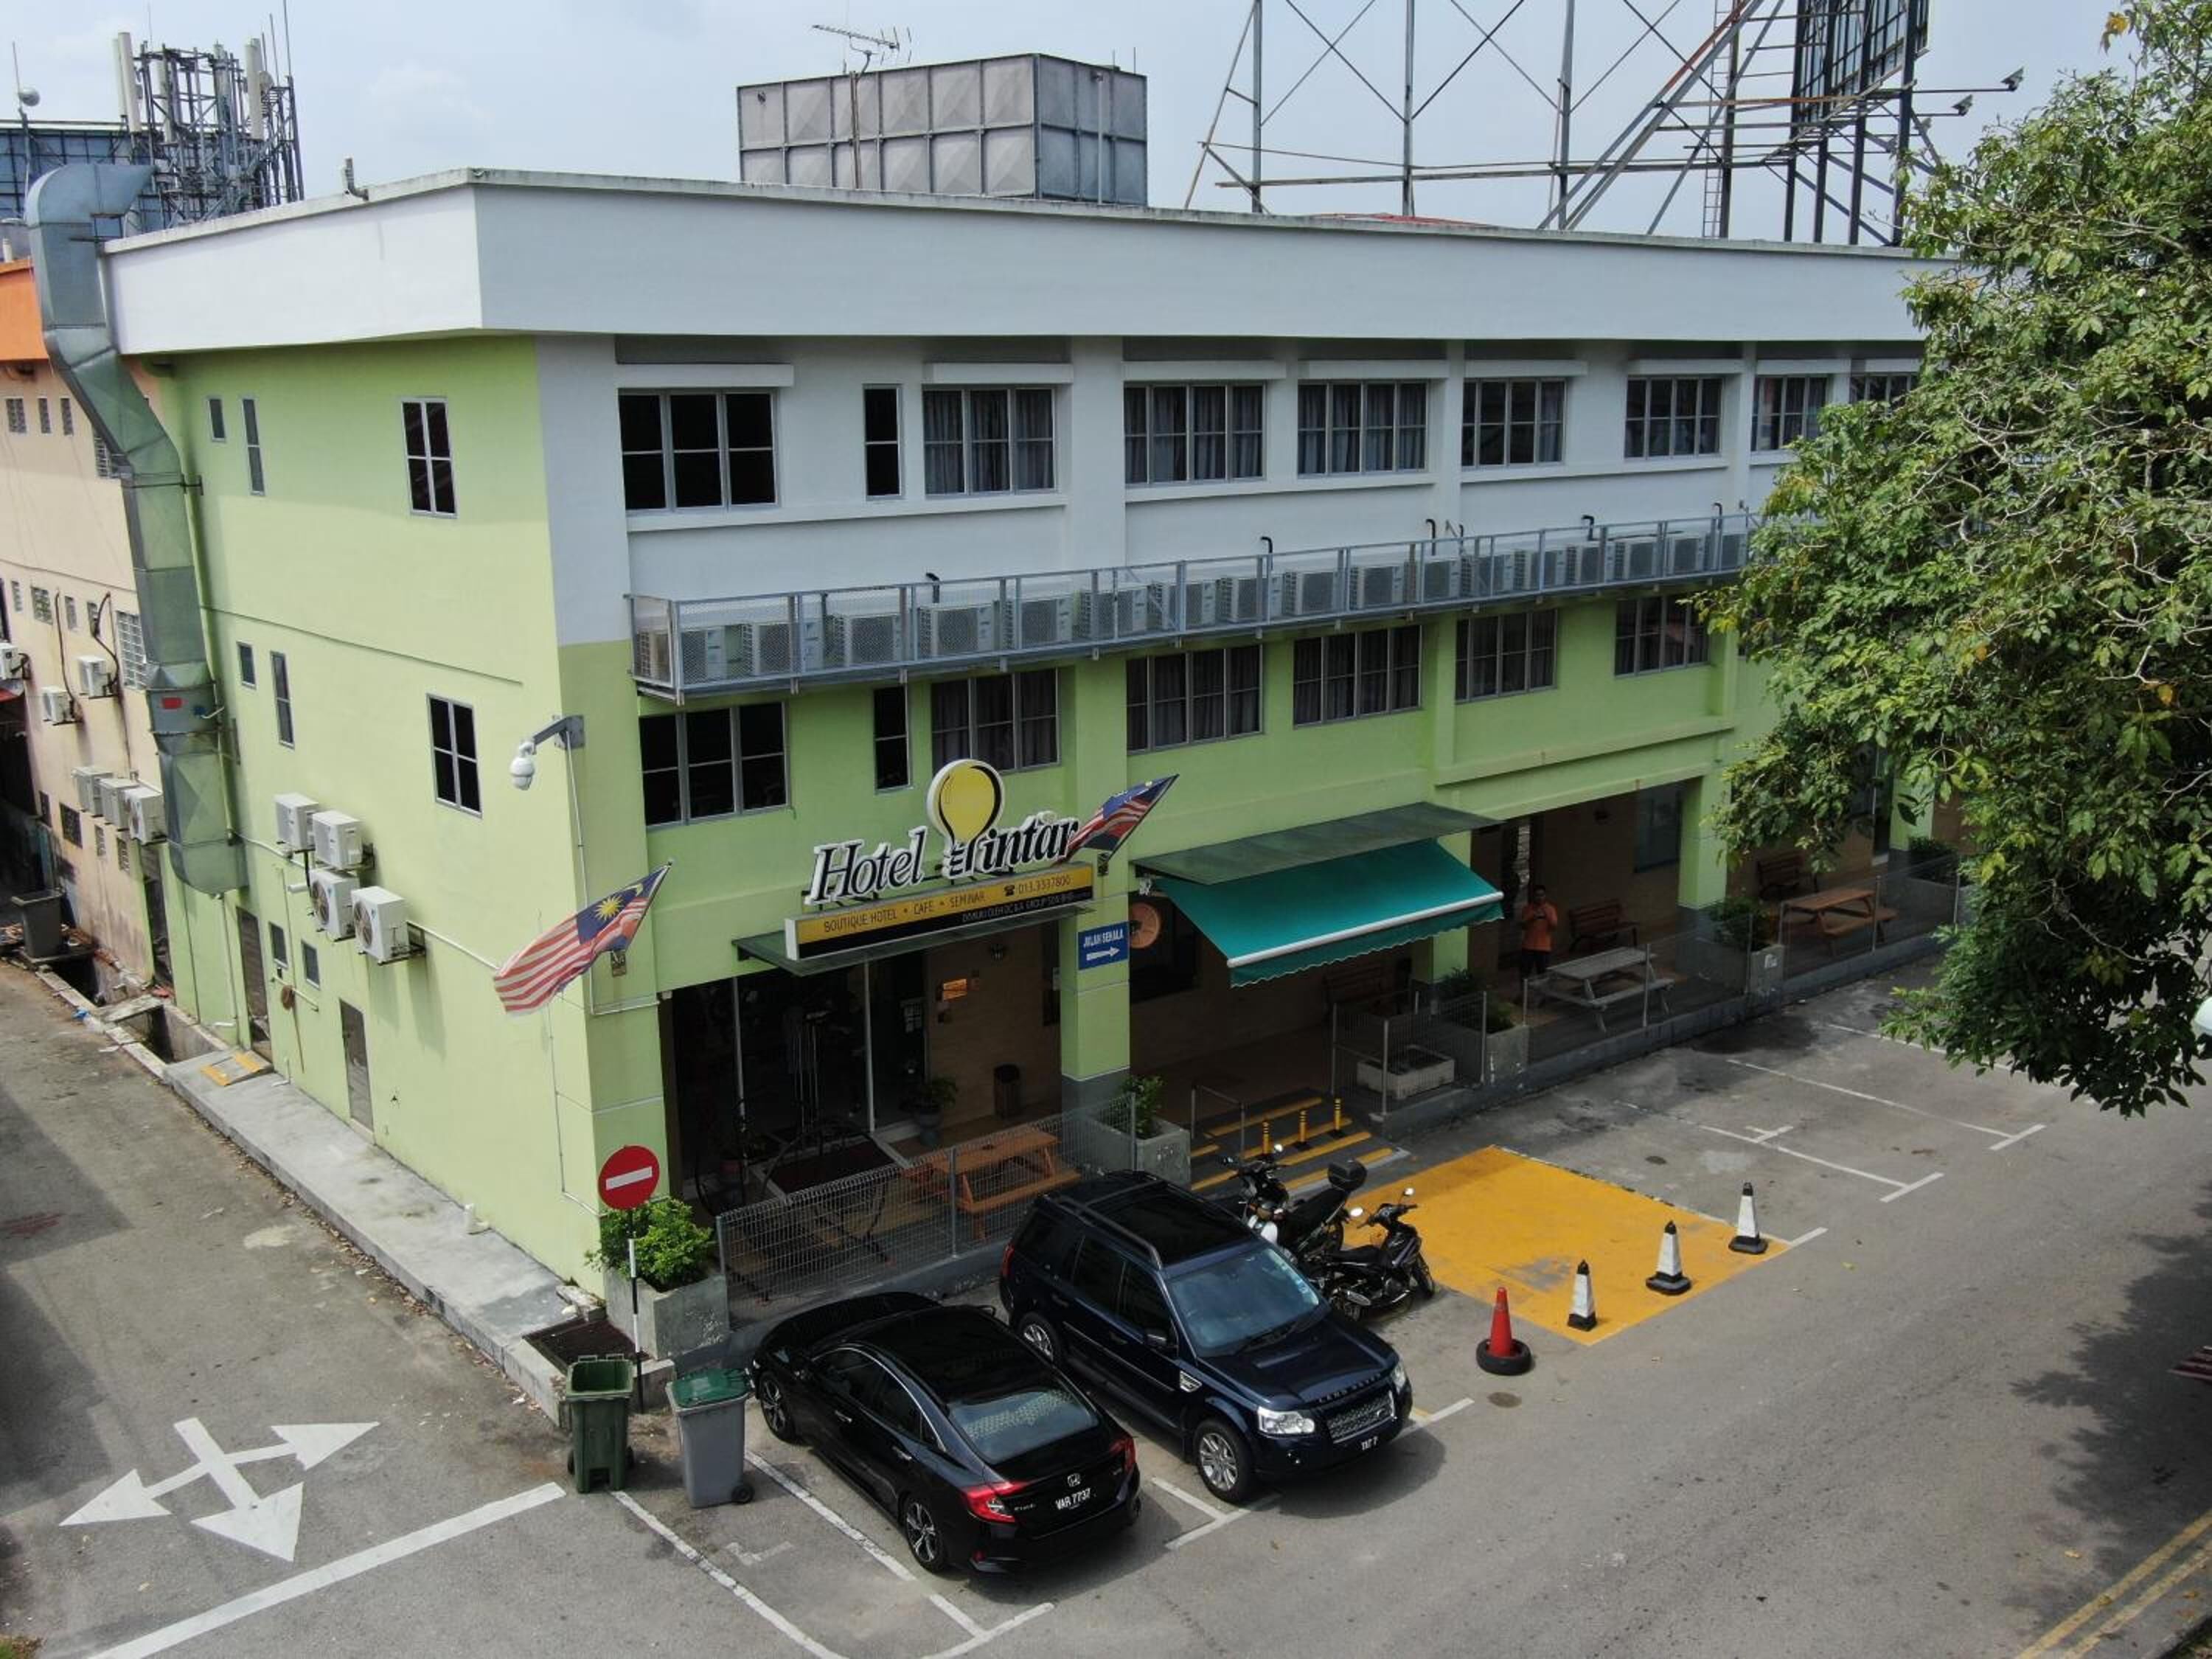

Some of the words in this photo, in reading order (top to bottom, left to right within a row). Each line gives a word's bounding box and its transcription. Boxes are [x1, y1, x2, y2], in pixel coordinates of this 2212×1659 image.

[805, 826, 928, 905] Hotel
[824, 914, 870, 933] BOUTIQUE
[871, 909, 897, 923] HOTEL
[913, 901, 934, 915] CAFE
[949, 891, 986, 908] SEMINAR
[1083, 933, 1102, 948] JALAN
